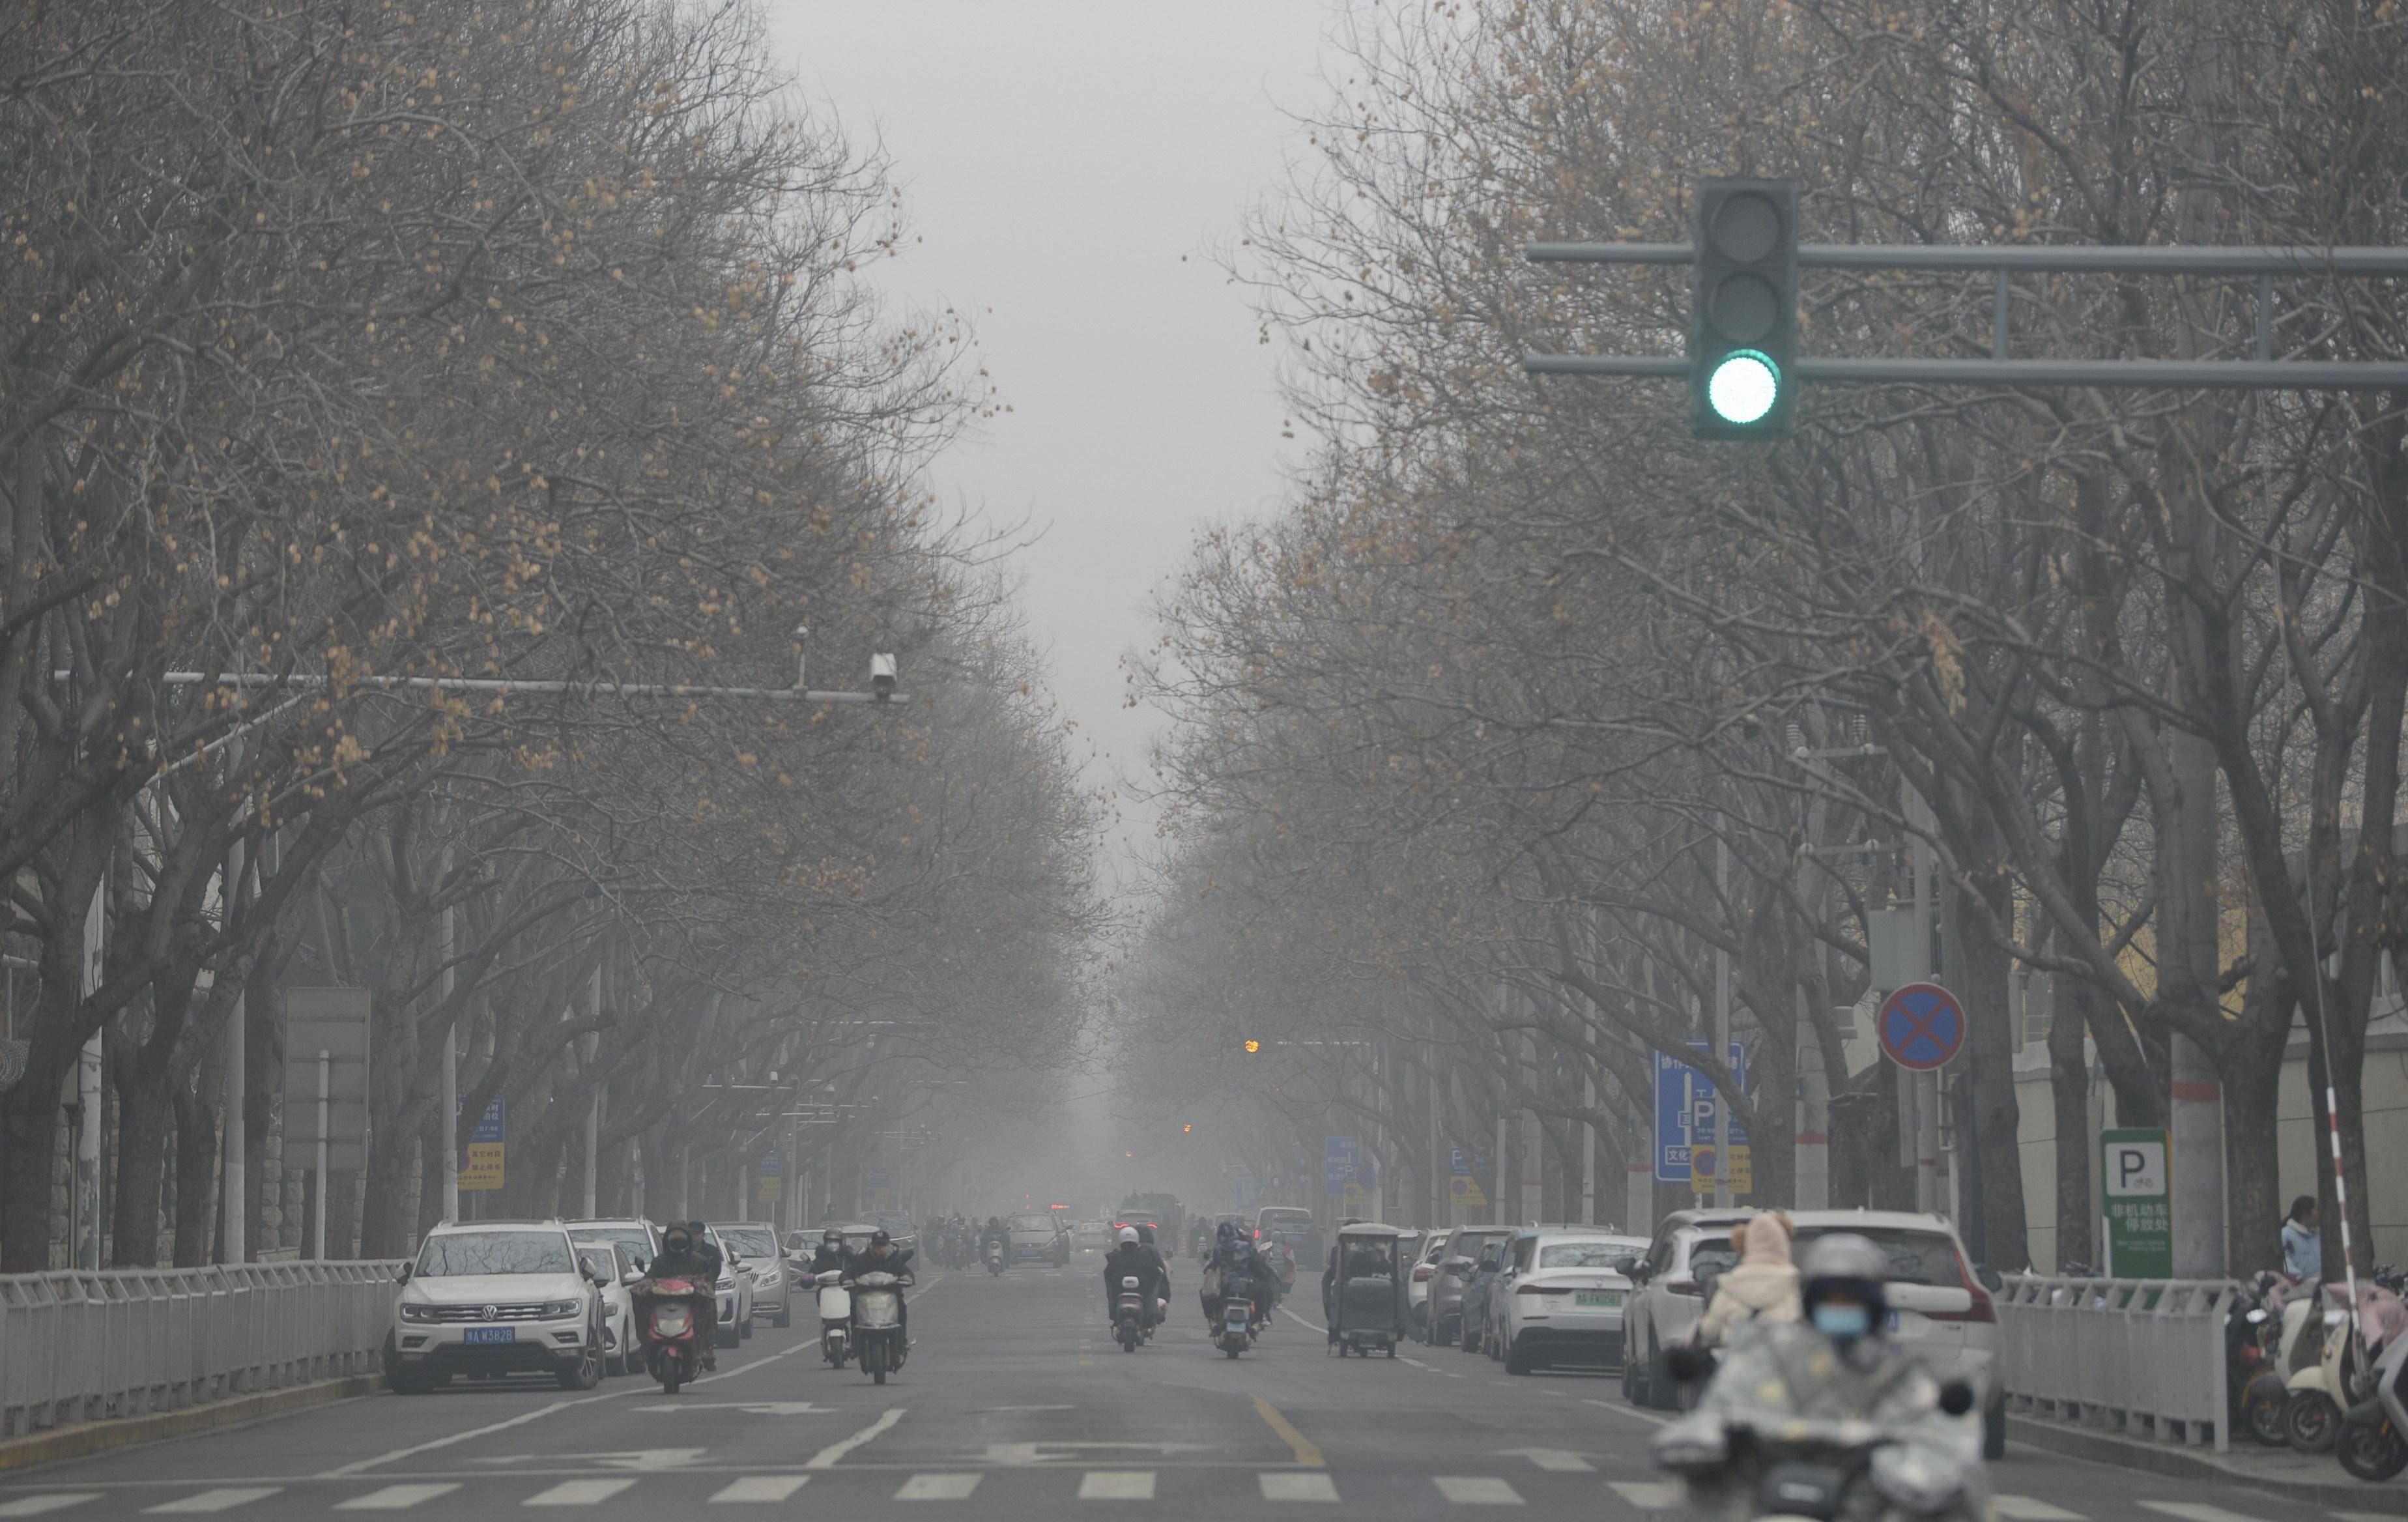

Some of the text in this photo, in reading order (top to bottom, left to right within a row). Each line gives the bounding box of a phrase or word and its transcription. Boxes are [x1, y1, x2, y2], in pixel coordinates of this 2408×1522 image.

[1694, 1101, 1713, 1126] P
[1669, 1149, 1691, 1161] 文化
[2120, 1150, 2145, 1188] P
[2111, 1203, 2168, 1218] 非机动车
[2126, 1217, 2169, 1231] 停放处
